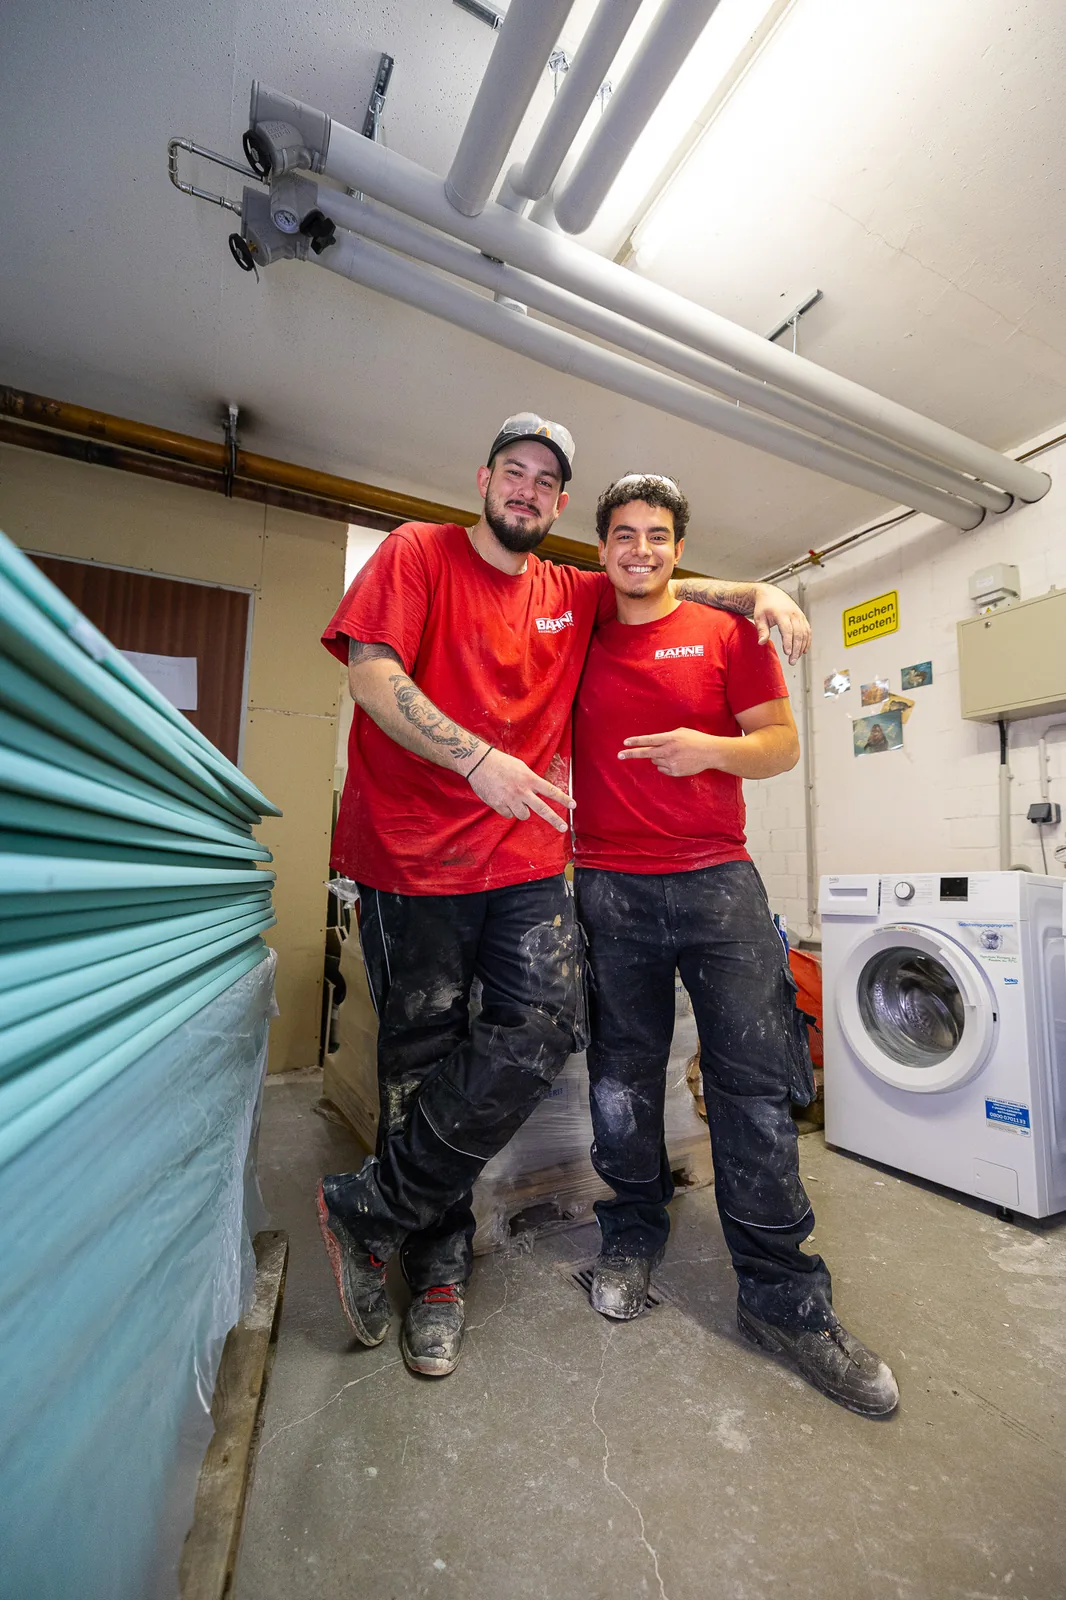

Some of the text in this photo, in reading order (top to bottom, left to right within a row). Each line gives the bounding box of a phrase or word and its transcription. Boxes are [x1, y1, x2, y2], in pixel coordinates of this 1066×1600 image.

[847, 613, 896, 638] verboten!
[848, 603, 894, 626] Rauchen
[655, 645, 704, 658] BAHNE
